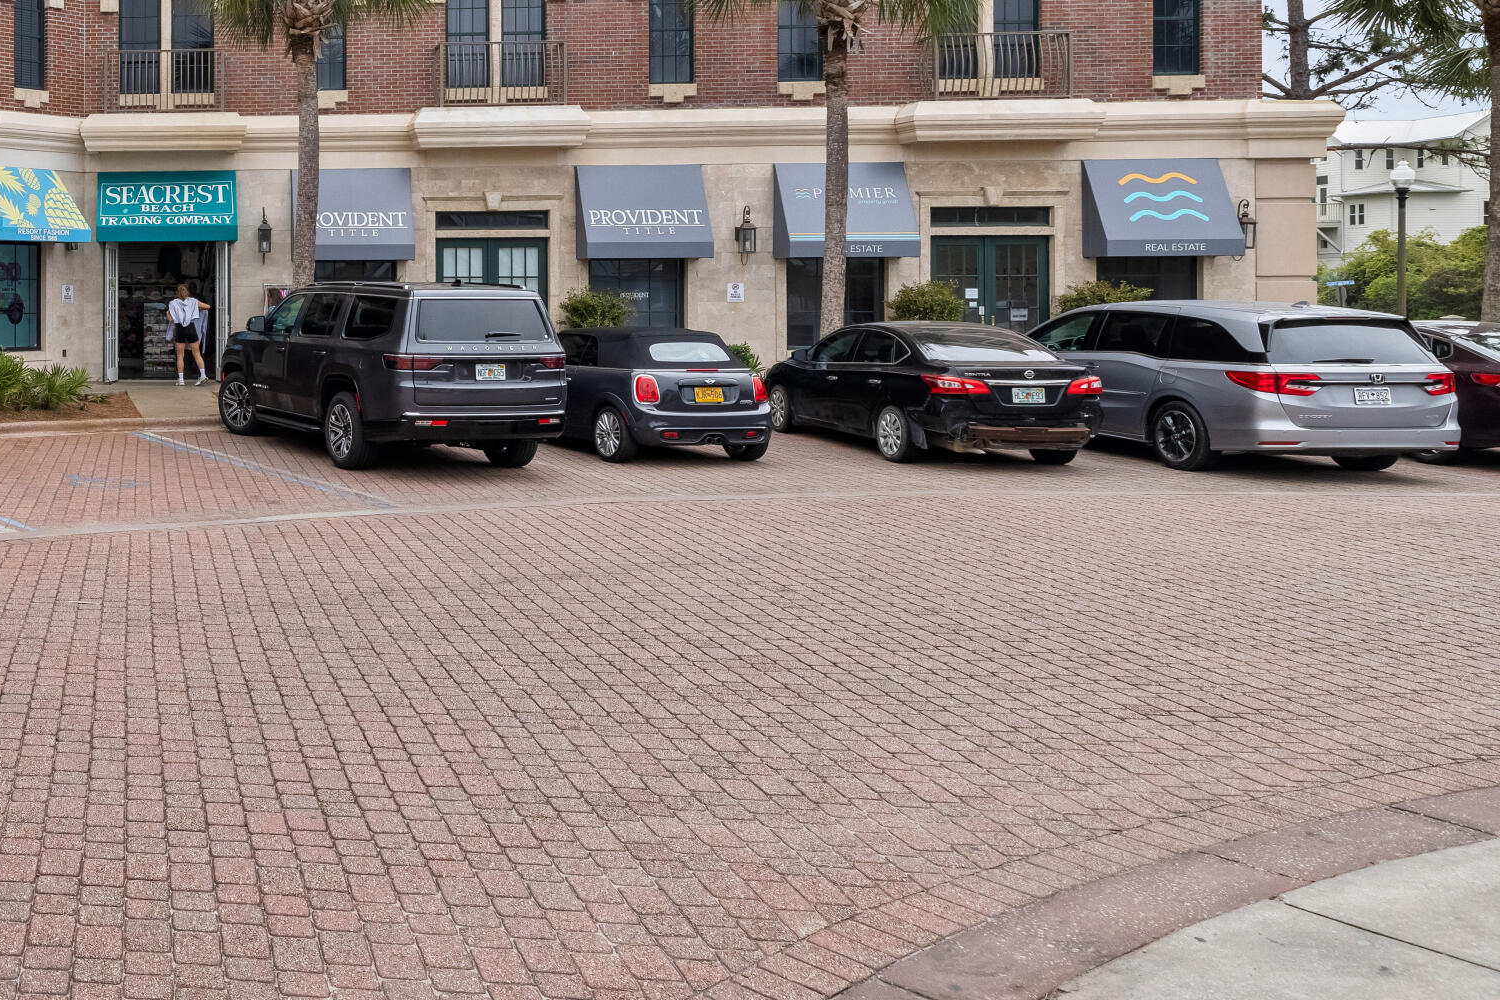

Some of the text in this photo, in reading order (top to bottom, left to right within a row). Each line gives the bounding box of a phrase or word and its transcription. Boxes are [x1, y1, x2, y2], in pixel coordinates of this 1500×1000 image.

[105, 184, 229, 205] SEACREST
[813, 187, 897, 199] PMIER
[140, 203, 195, 213] BEACH
[100, 215, 233, 226] TRADING COMPANY
[589, 209, 703, 226] PROVIDENT
[18, 227, 41, 235] RESORT
[328, 229, 379, 237] TITLE
[623, 227, 676, 235] TITLE
[850, 245, 883, 253] ESTATE
[1145, 243, 1207, 251] REAL ESTATE
